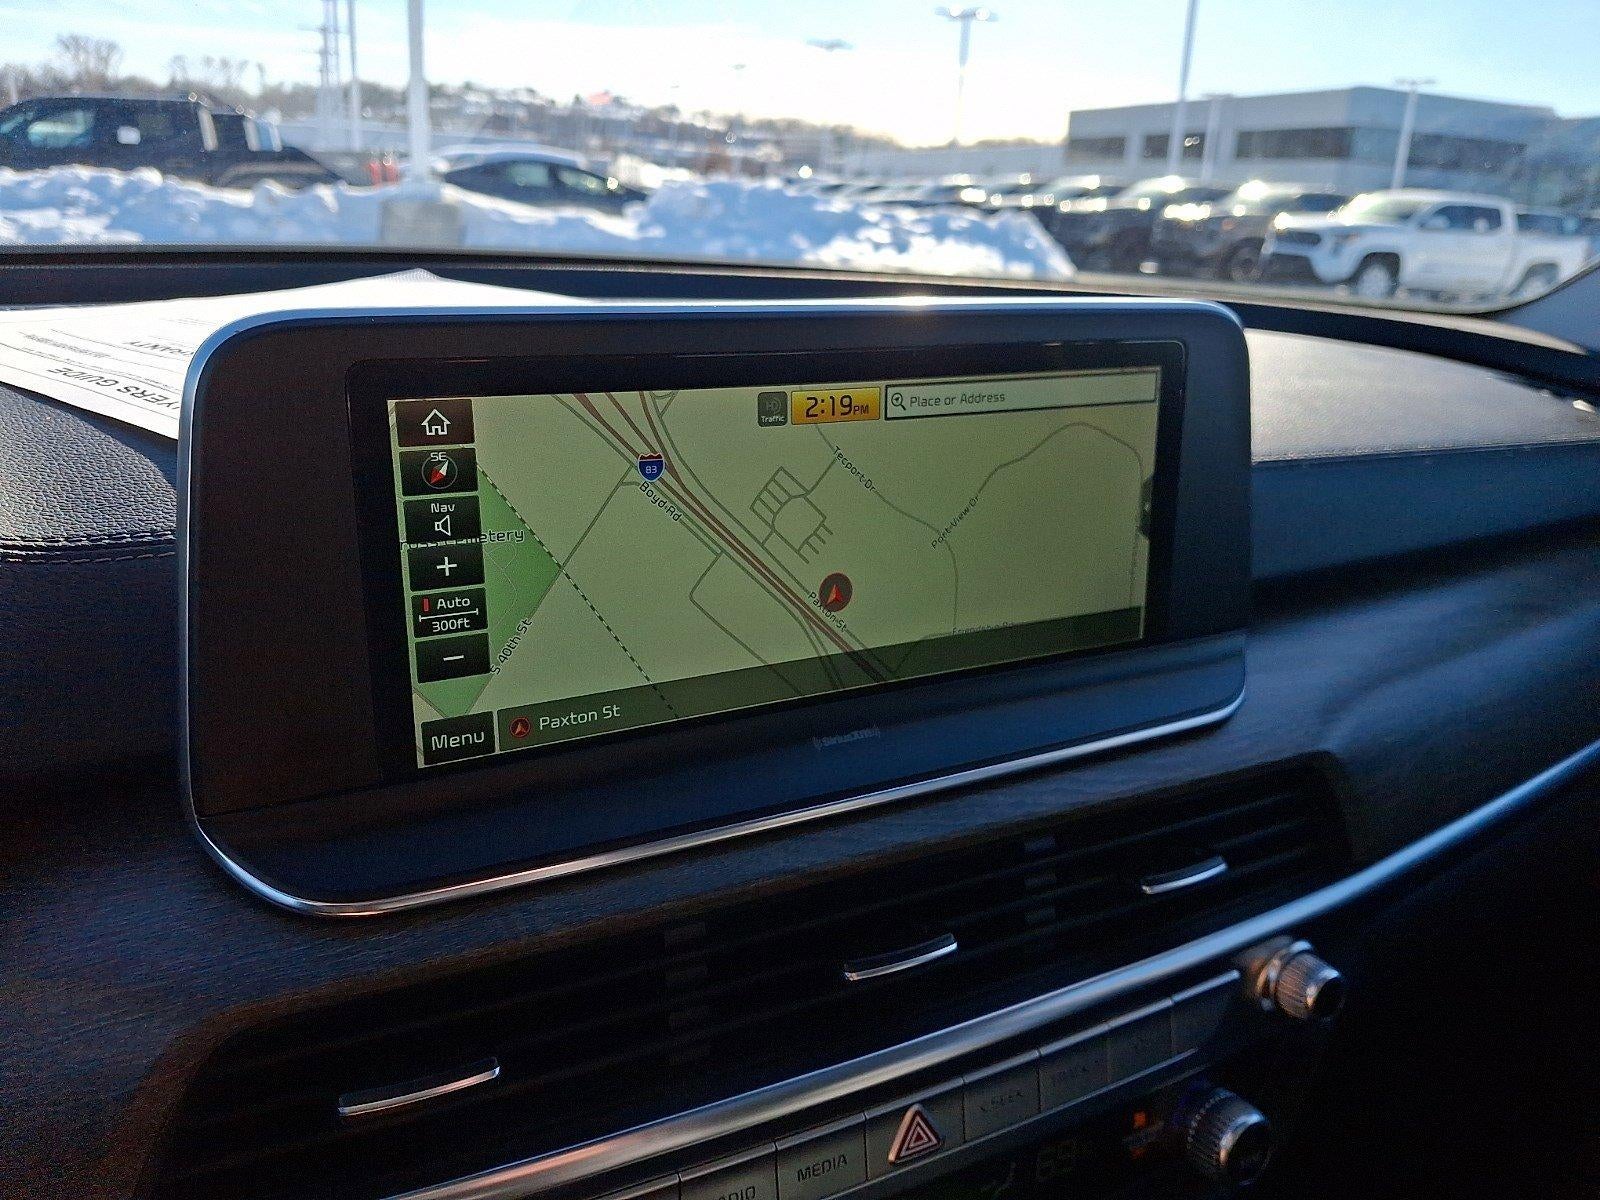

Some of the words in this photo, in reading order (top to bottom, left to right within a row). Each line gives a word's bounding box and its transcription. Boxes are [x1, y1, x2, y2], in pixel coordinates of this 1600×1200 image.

[46, 367, 120, 387] GUIDE
[116, 385, 181, 410] YERS
[909, 396, 941, 408] Place
[944, 396, 957, 406] or
[960, 392, 1006, 405] Address
[761, 415, 785, 423] Traffic
[430, 451, 447, 462] SE
[645, 465, 658, 474] 83
[833, 445, 866, 483] Tecport
[864, 479, 876, 492] Dr
[430, 503, 455, 513] Nav
[639, 481, 668, 508] Boyd
[665, 505, 683, 522] Rd
[931, 528, 951, 549] Port
[437, 596, 471, 610] Auto
[808, 591, 837, 623] Paxton
[836, 619, 847, 633] St
[431, 617, 471, 633] 300ft
[490, 664, 501, 675] S
[498, 635, 522, 663] 40th
[516, 618, 533, 634] St
[539, 710, 598, 731] Paxton
[602, 704, 621, 719] St
[431, 730, 485, 751] Menu
[797, 1153, 848, 1183] MEDIA
